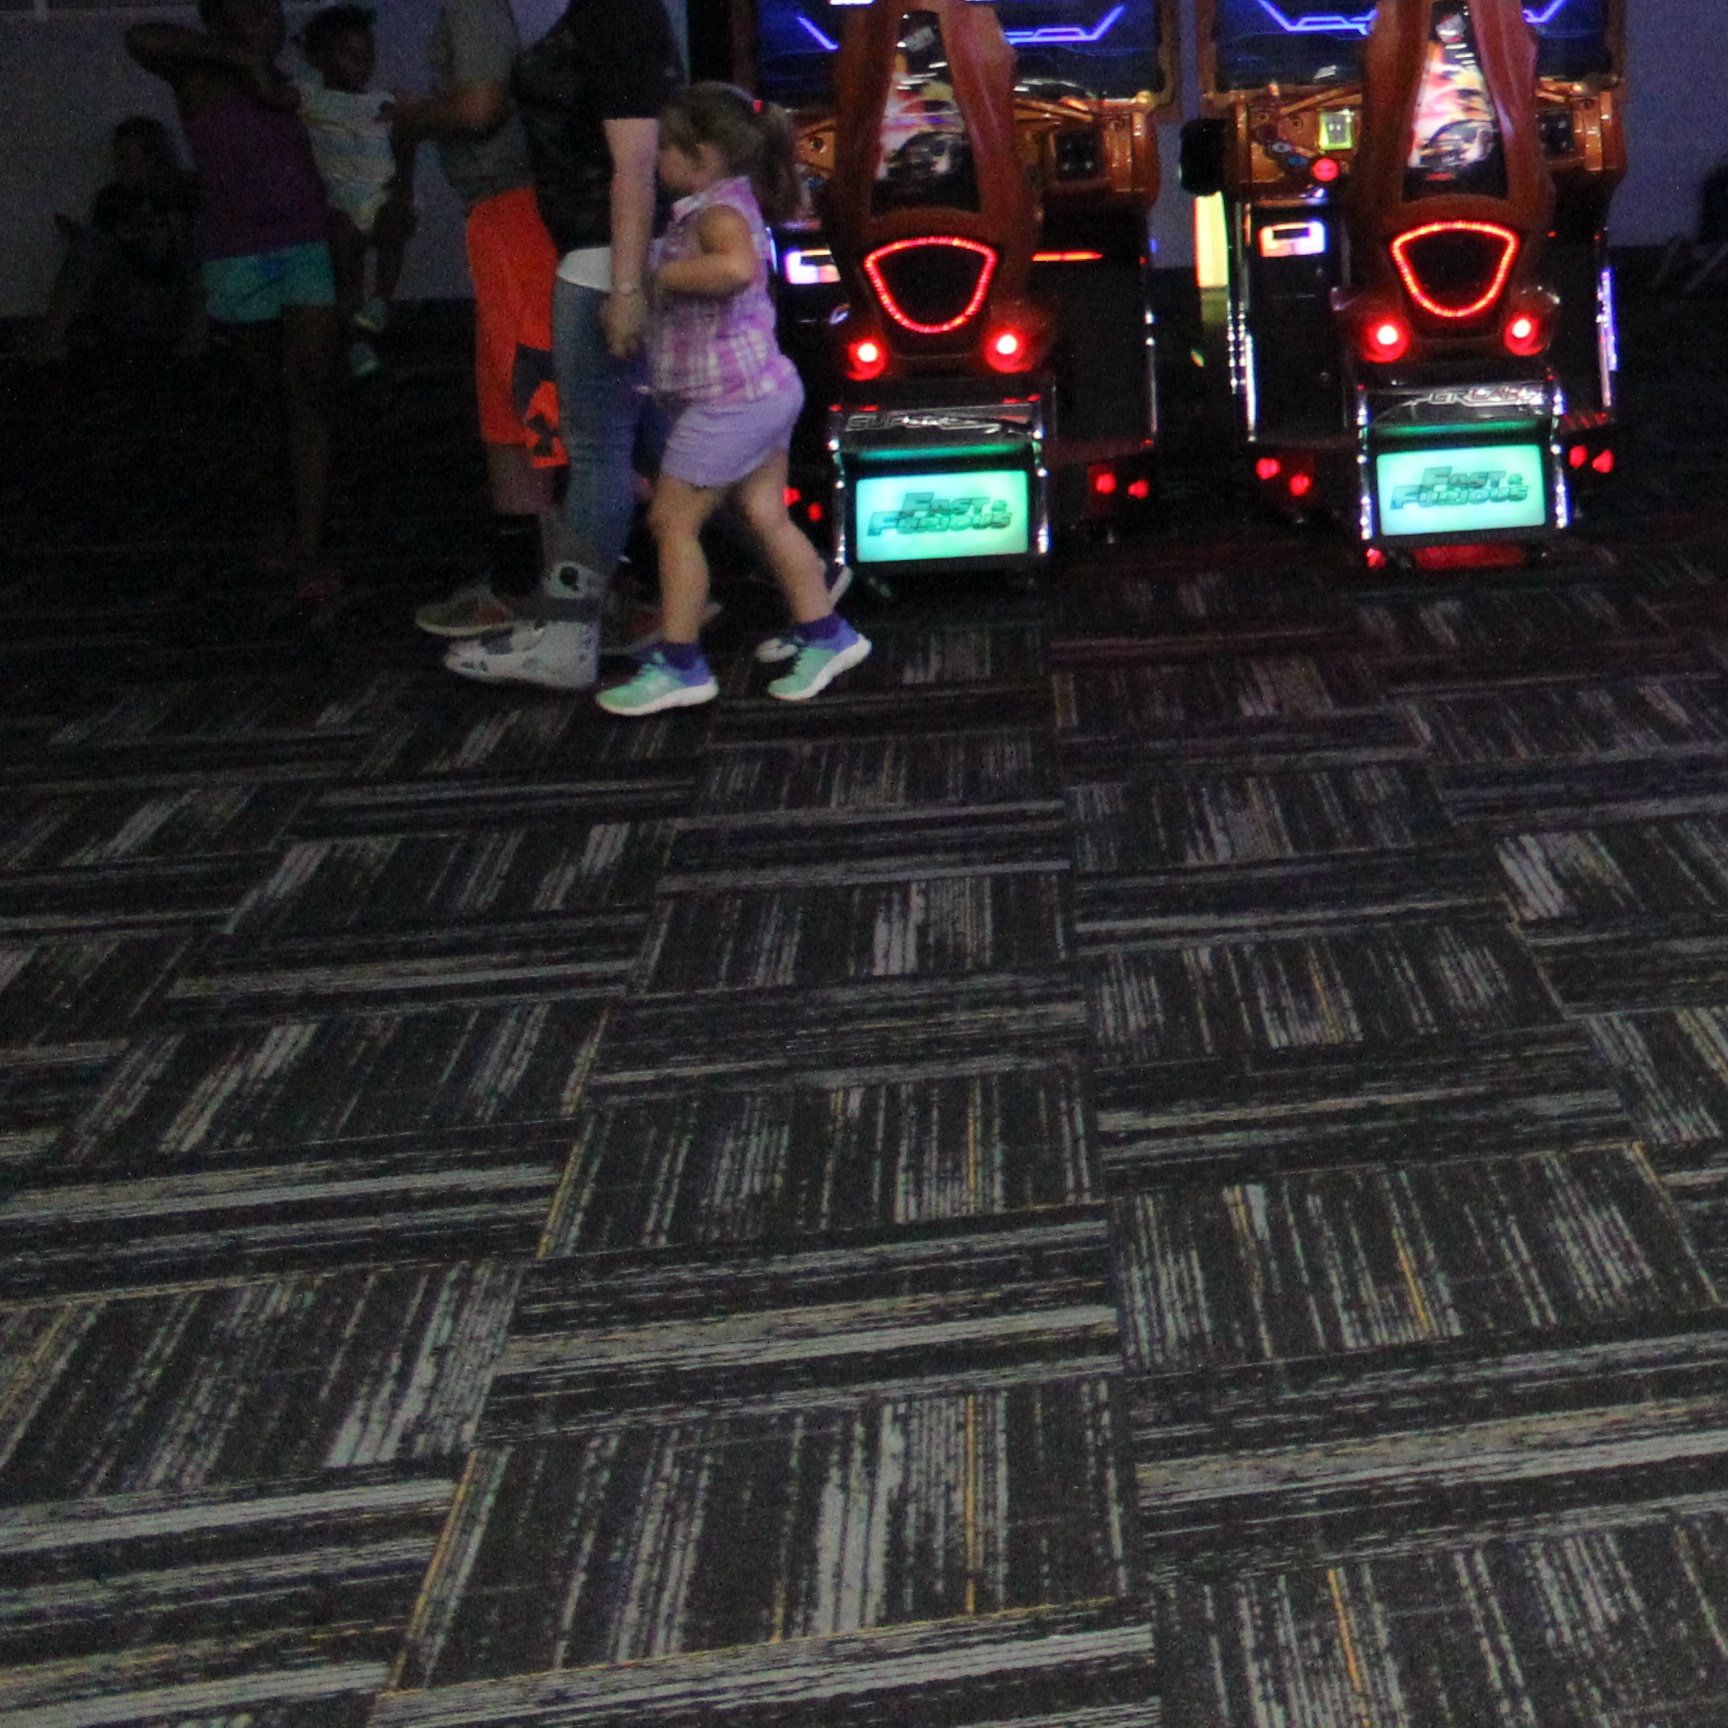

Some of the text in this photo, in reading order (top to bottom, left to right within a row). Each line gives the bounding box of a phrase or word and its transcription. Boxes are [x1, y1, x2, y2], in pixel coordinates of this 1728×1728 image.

[1422, 466, 1507, 490] FAST
[902, 491, 990, 517] FAST
[1389, 484, 1529, 510] FURIOUS
[867, 510, 1012, 537] FURIOUS
